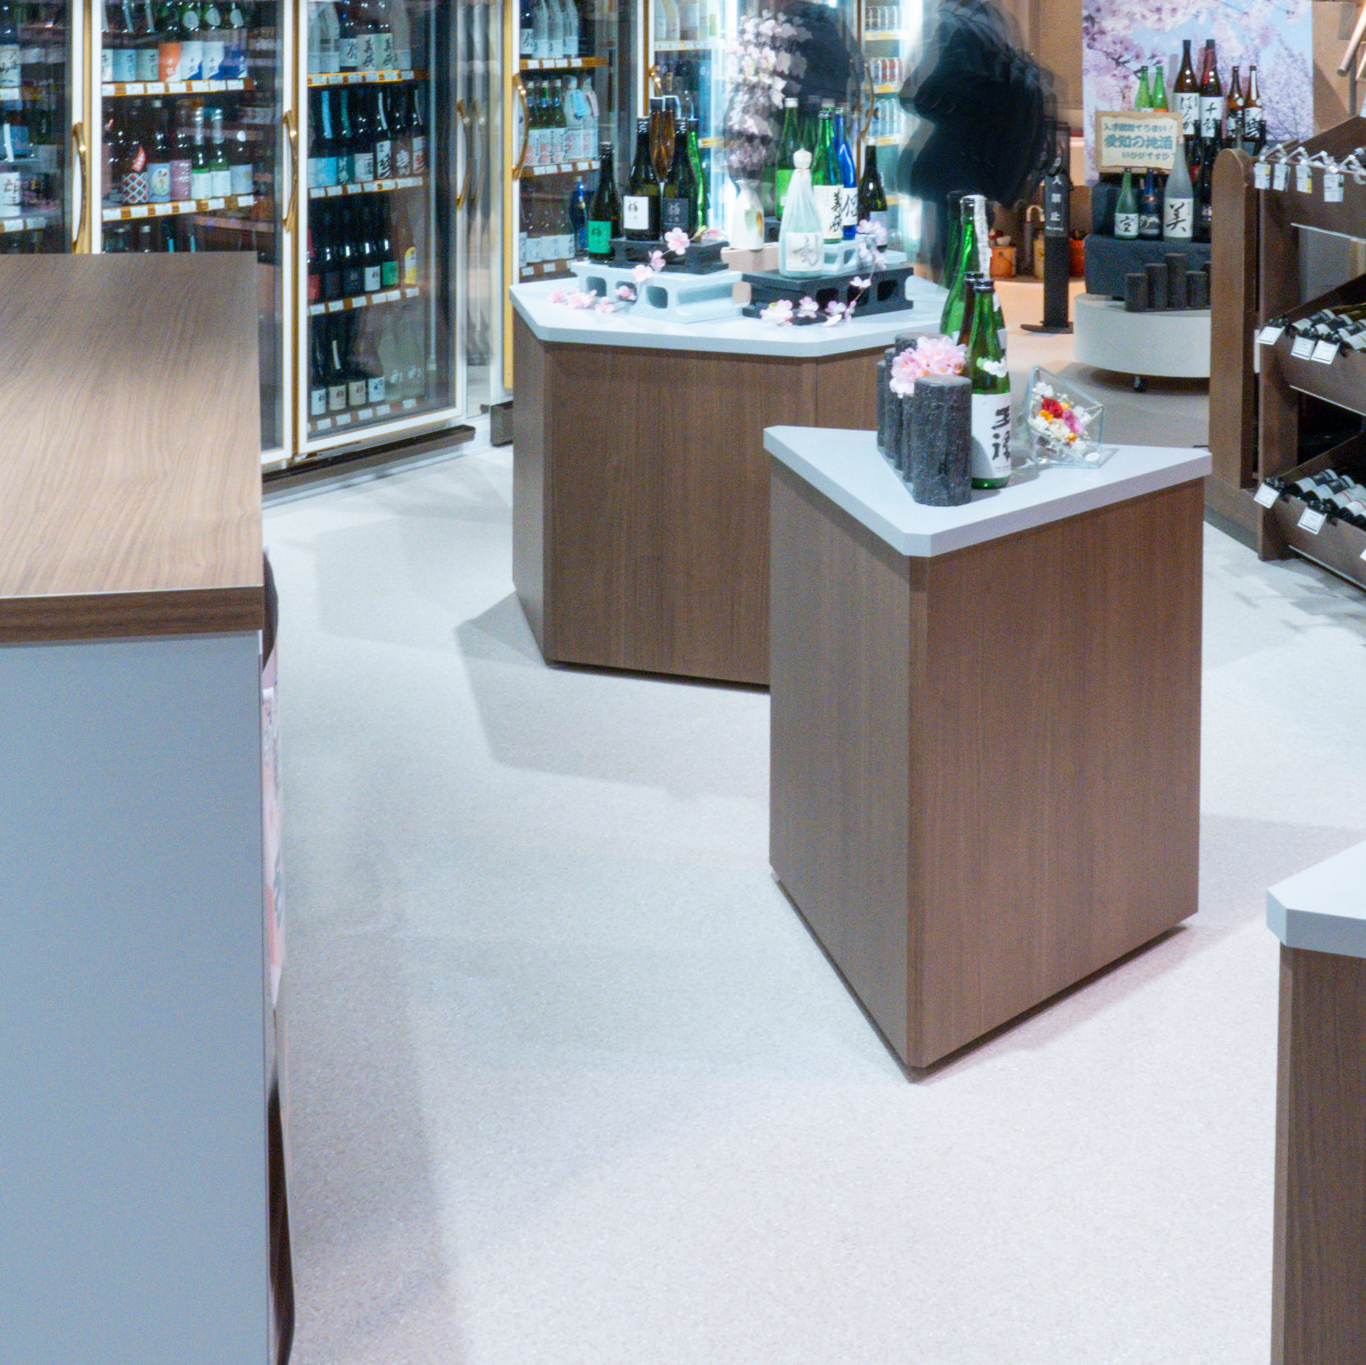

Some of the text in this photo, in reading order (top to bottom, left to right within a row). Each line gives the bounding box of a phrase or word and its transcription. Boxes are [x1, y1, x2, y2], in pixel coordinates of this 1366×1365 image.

[1104, 134, 1173, 150] 愛知の地酒
[1166, 201, 1186, 232] 美
